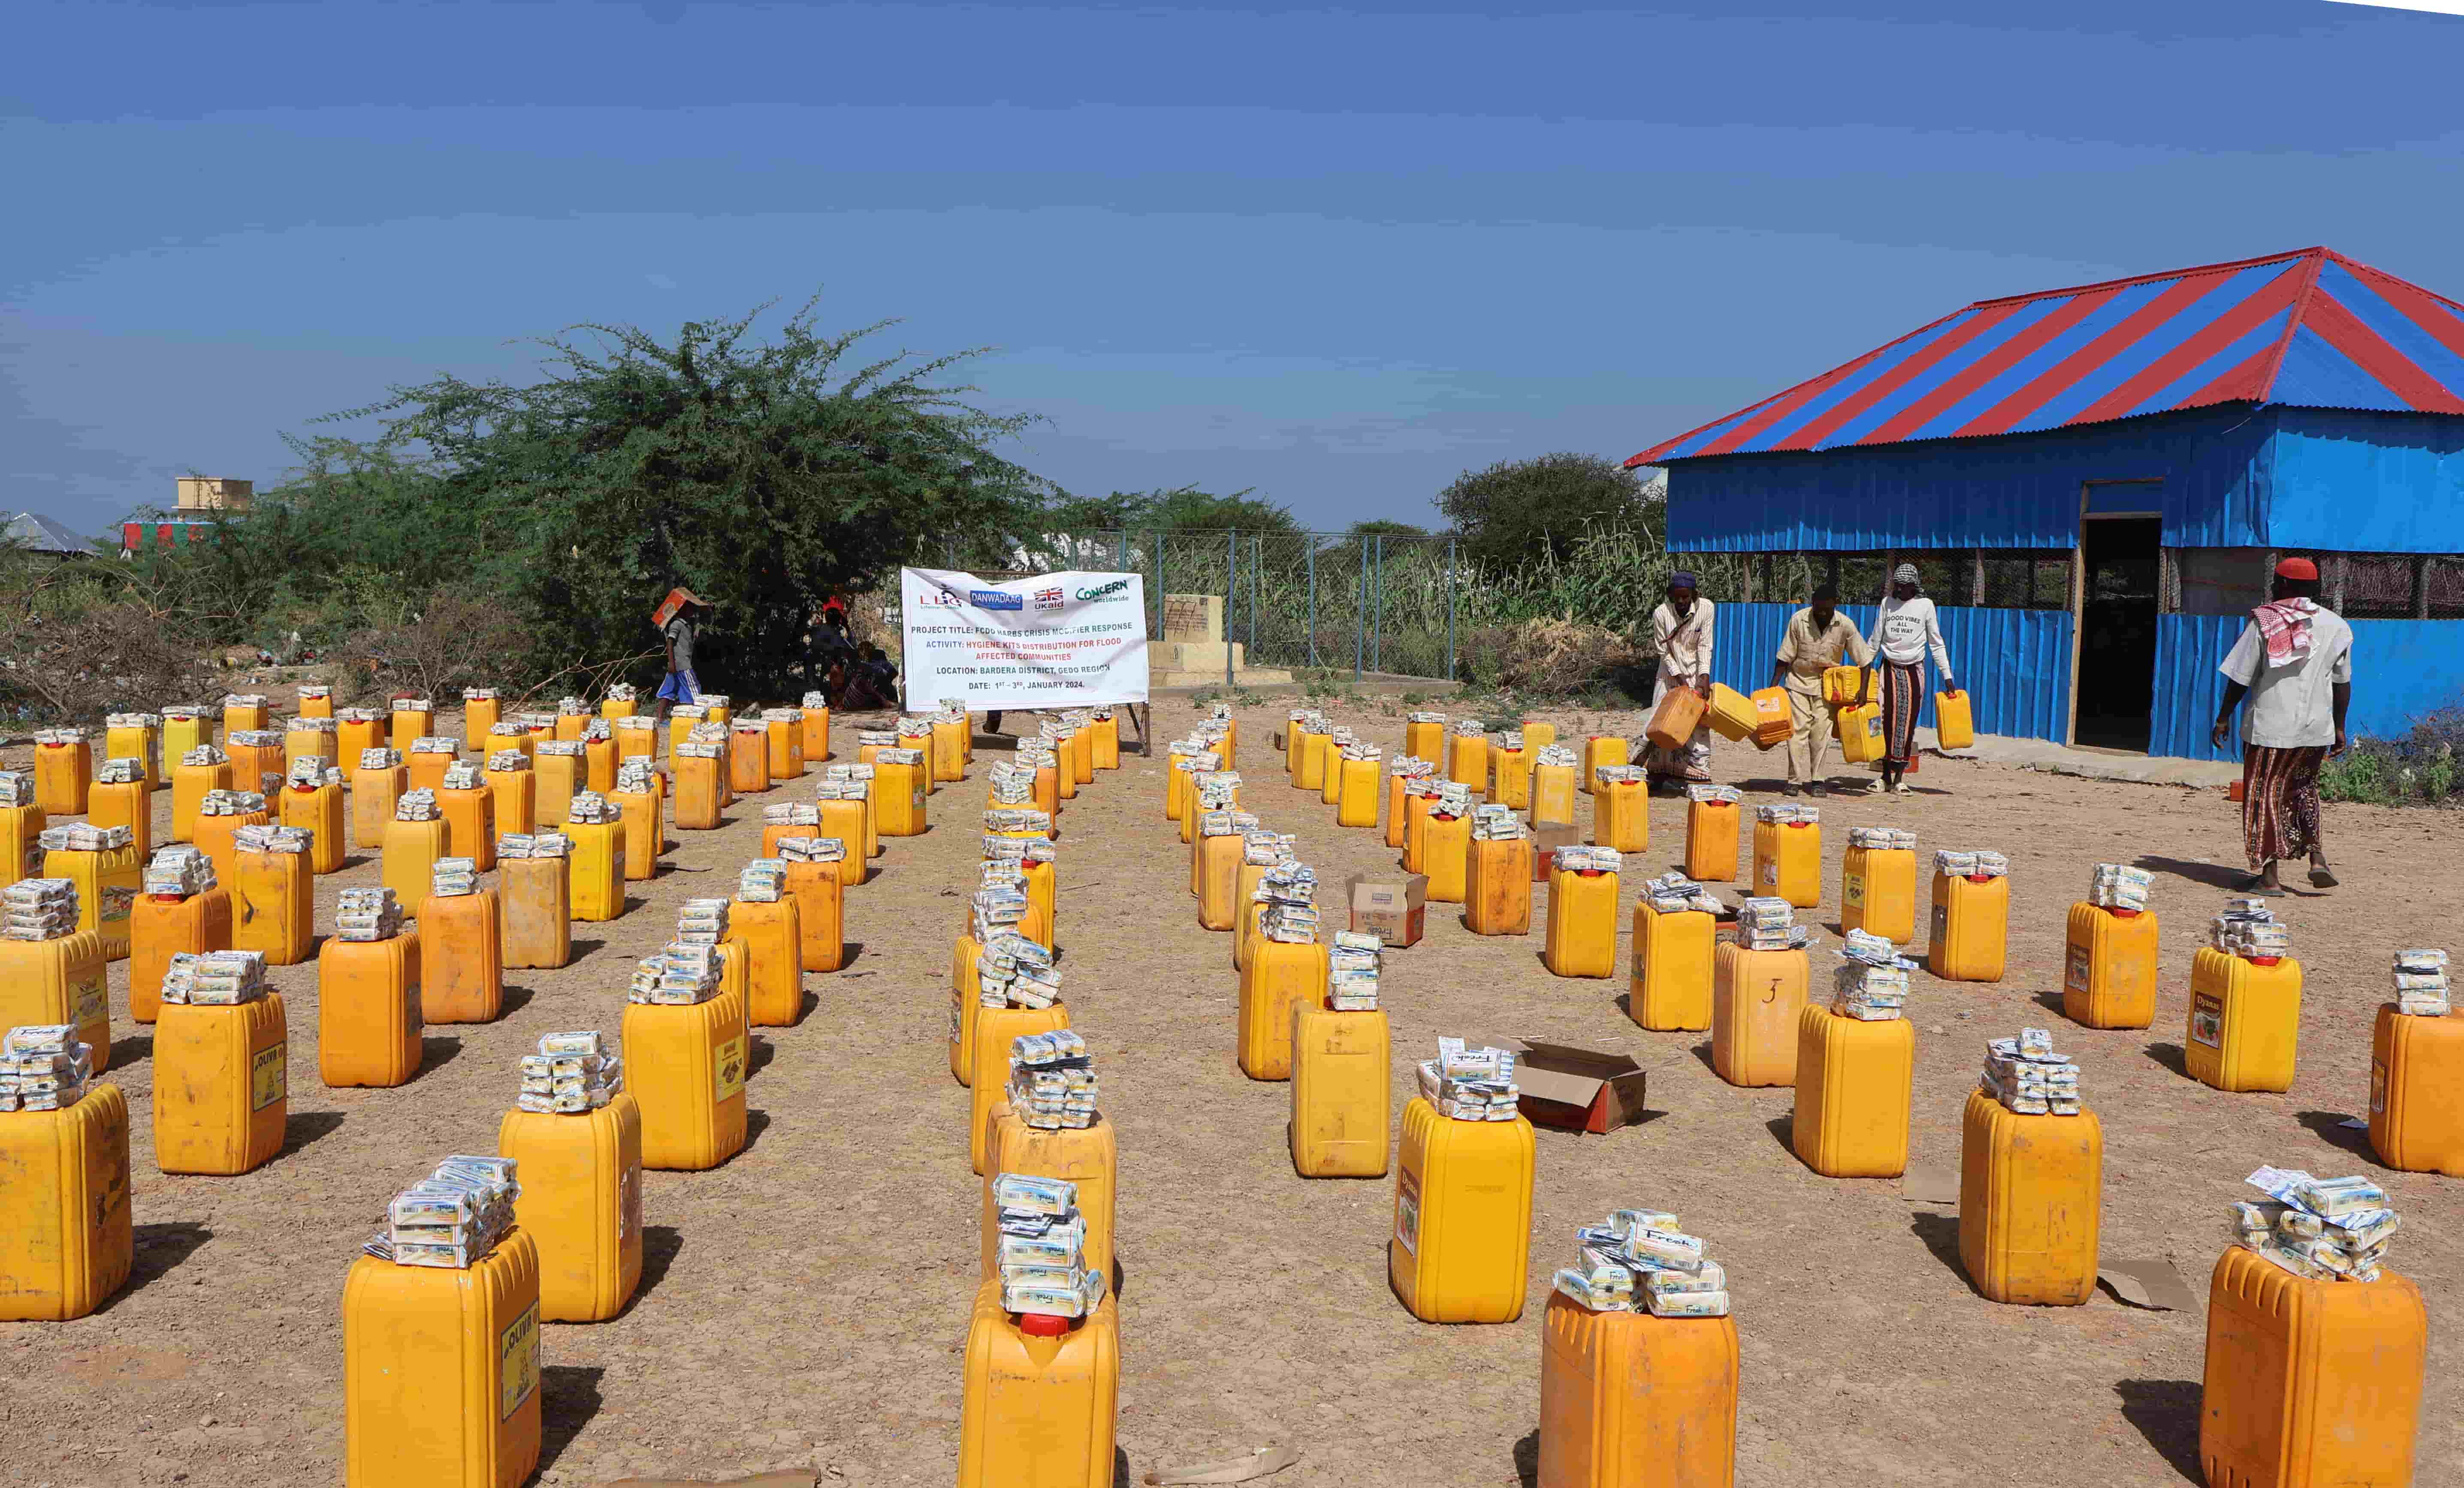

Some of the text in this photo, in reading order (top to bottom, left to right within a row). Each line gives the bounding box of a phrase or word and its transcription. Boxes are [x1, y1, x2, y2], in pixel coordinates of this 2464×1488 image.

[971, 593, 1021, 603] DANWADAAG
[1024, 628, 1050, 637] CRISIS
[1052, 625, 1090, 635] MODFIER
[1092, 622, 1132, 632] RESPONSE
[1023, 641, 1076, 650] DISTRIBUTION
[1079, 640, 1094, 648] FOR
[1096, 638, 1121, 646] FLOOD
[1019, 667, 1056, 676] DISTRICT,
[1081, 664, 1110, 673] REGION
[258, 1050, 277, 1067] OLIVA
[1642, 1228, 1694, 1247] Fresh
[1663, 1283, 1680, 1293] Fresh
[1685, 1304, 1703, 1314] Fresh
[508, 1313, 532, 1349] OLIVA
